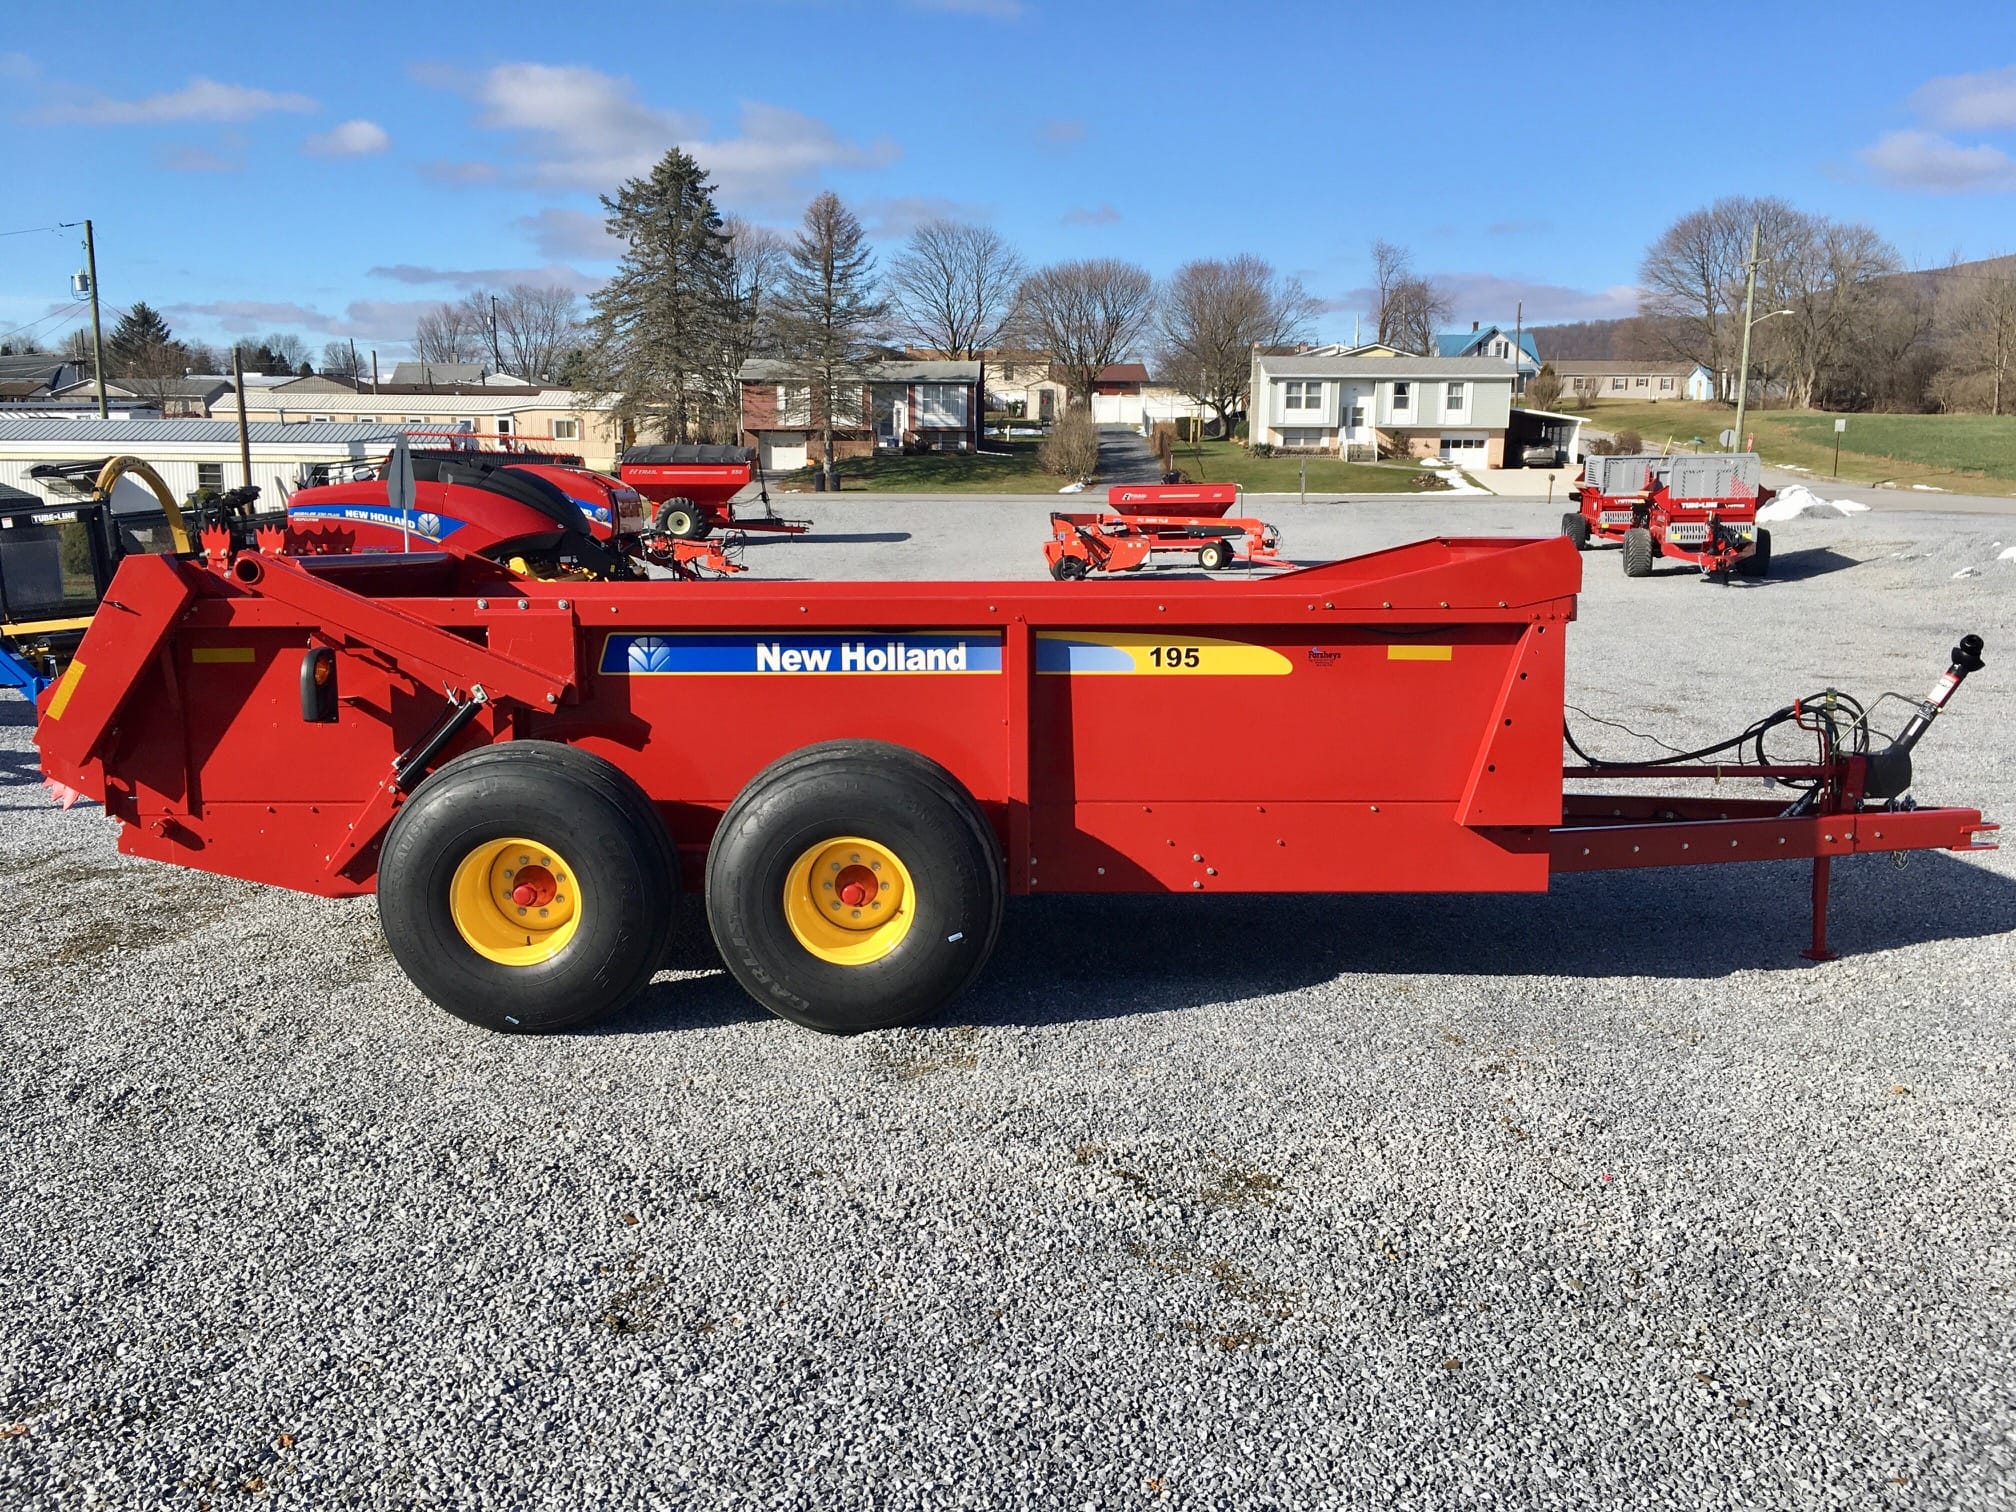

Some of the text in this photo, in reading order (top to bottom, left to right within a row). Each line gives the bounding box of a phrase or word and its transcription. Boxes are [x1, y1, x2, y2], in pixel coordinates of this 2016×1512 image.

[345, 509, 416, 529] NEW HOLLAND
[756, 641, 967, 671] New Holland
[1150, 646, 1200, 668] 195
[1308, 650, 1341, 660] Forsheys
